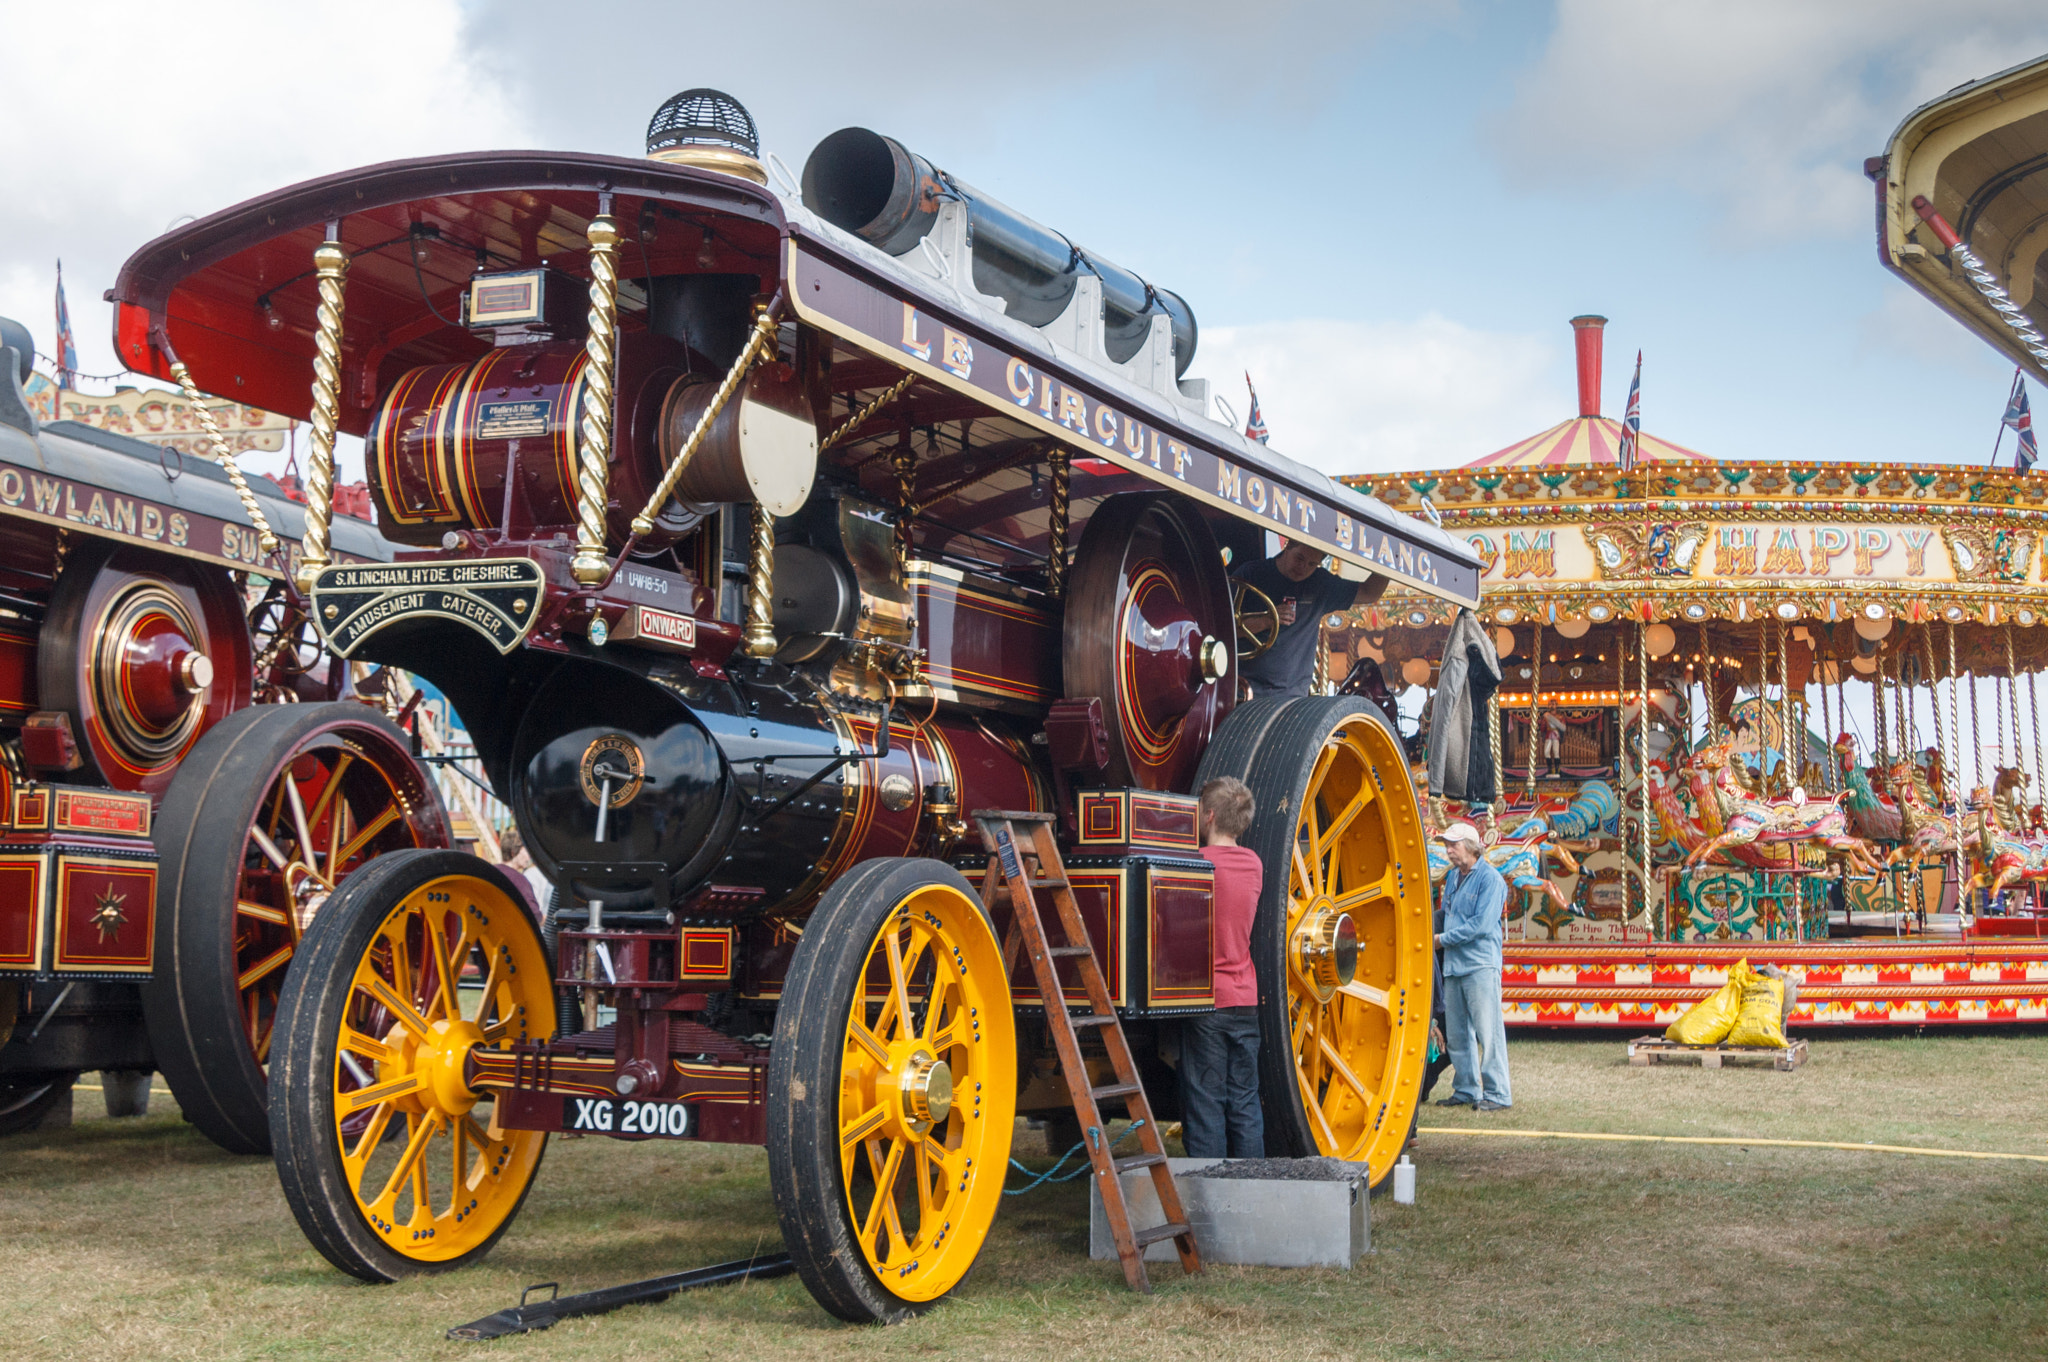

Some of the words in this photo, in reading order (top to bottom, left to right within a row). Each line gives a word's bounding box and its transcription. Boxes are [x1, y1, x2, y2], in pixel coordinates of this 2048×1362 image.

[901, 300, 974, 381] LE
[1006, 356, 1194, 481] CIRCUIT
[1216, 457, 1317, 534] MONT
[1712, 526, 1935, 577] HAPPY
[452, 565, 523, 582] CHESHIRE.
[347, 593, 426, 640] AMUSEMENT
[642, 612, 693, 642] ONWARD
[1569, 923, 1580, 933] To
[1629, 924, 1648, 934] Rid
[574, 1098, 614, 1131] XG
[620, 1100, 688, 1136] 2010
